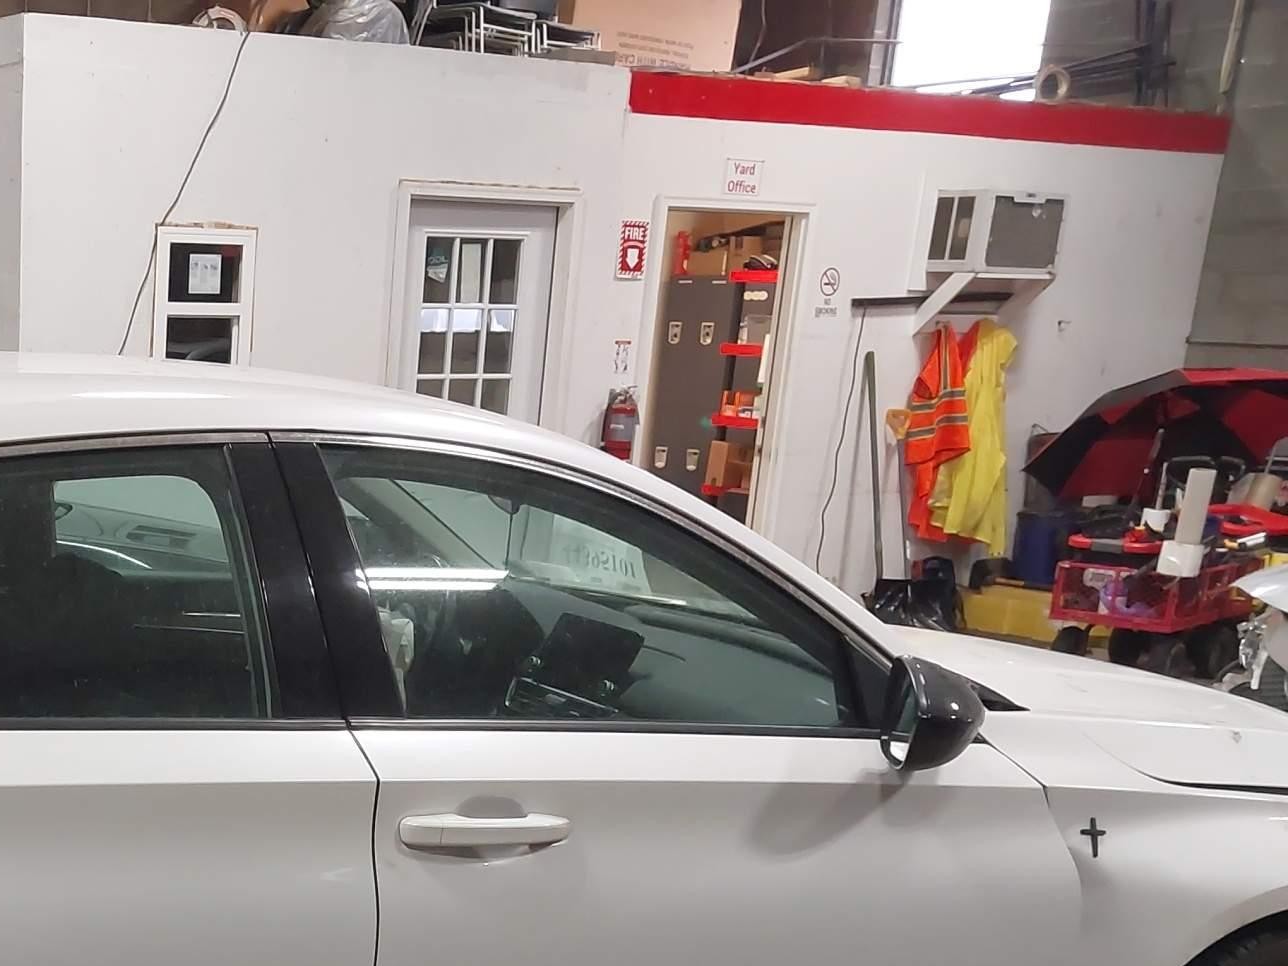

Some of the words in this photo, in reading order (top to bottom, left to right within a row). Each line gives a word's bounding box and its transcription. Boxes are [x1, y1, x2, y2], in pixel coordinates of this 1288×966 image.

[734, 161, 756, 176] Yard
[727, 180, 756, 194] Office
[624, 226, 645, 241] FIRE
